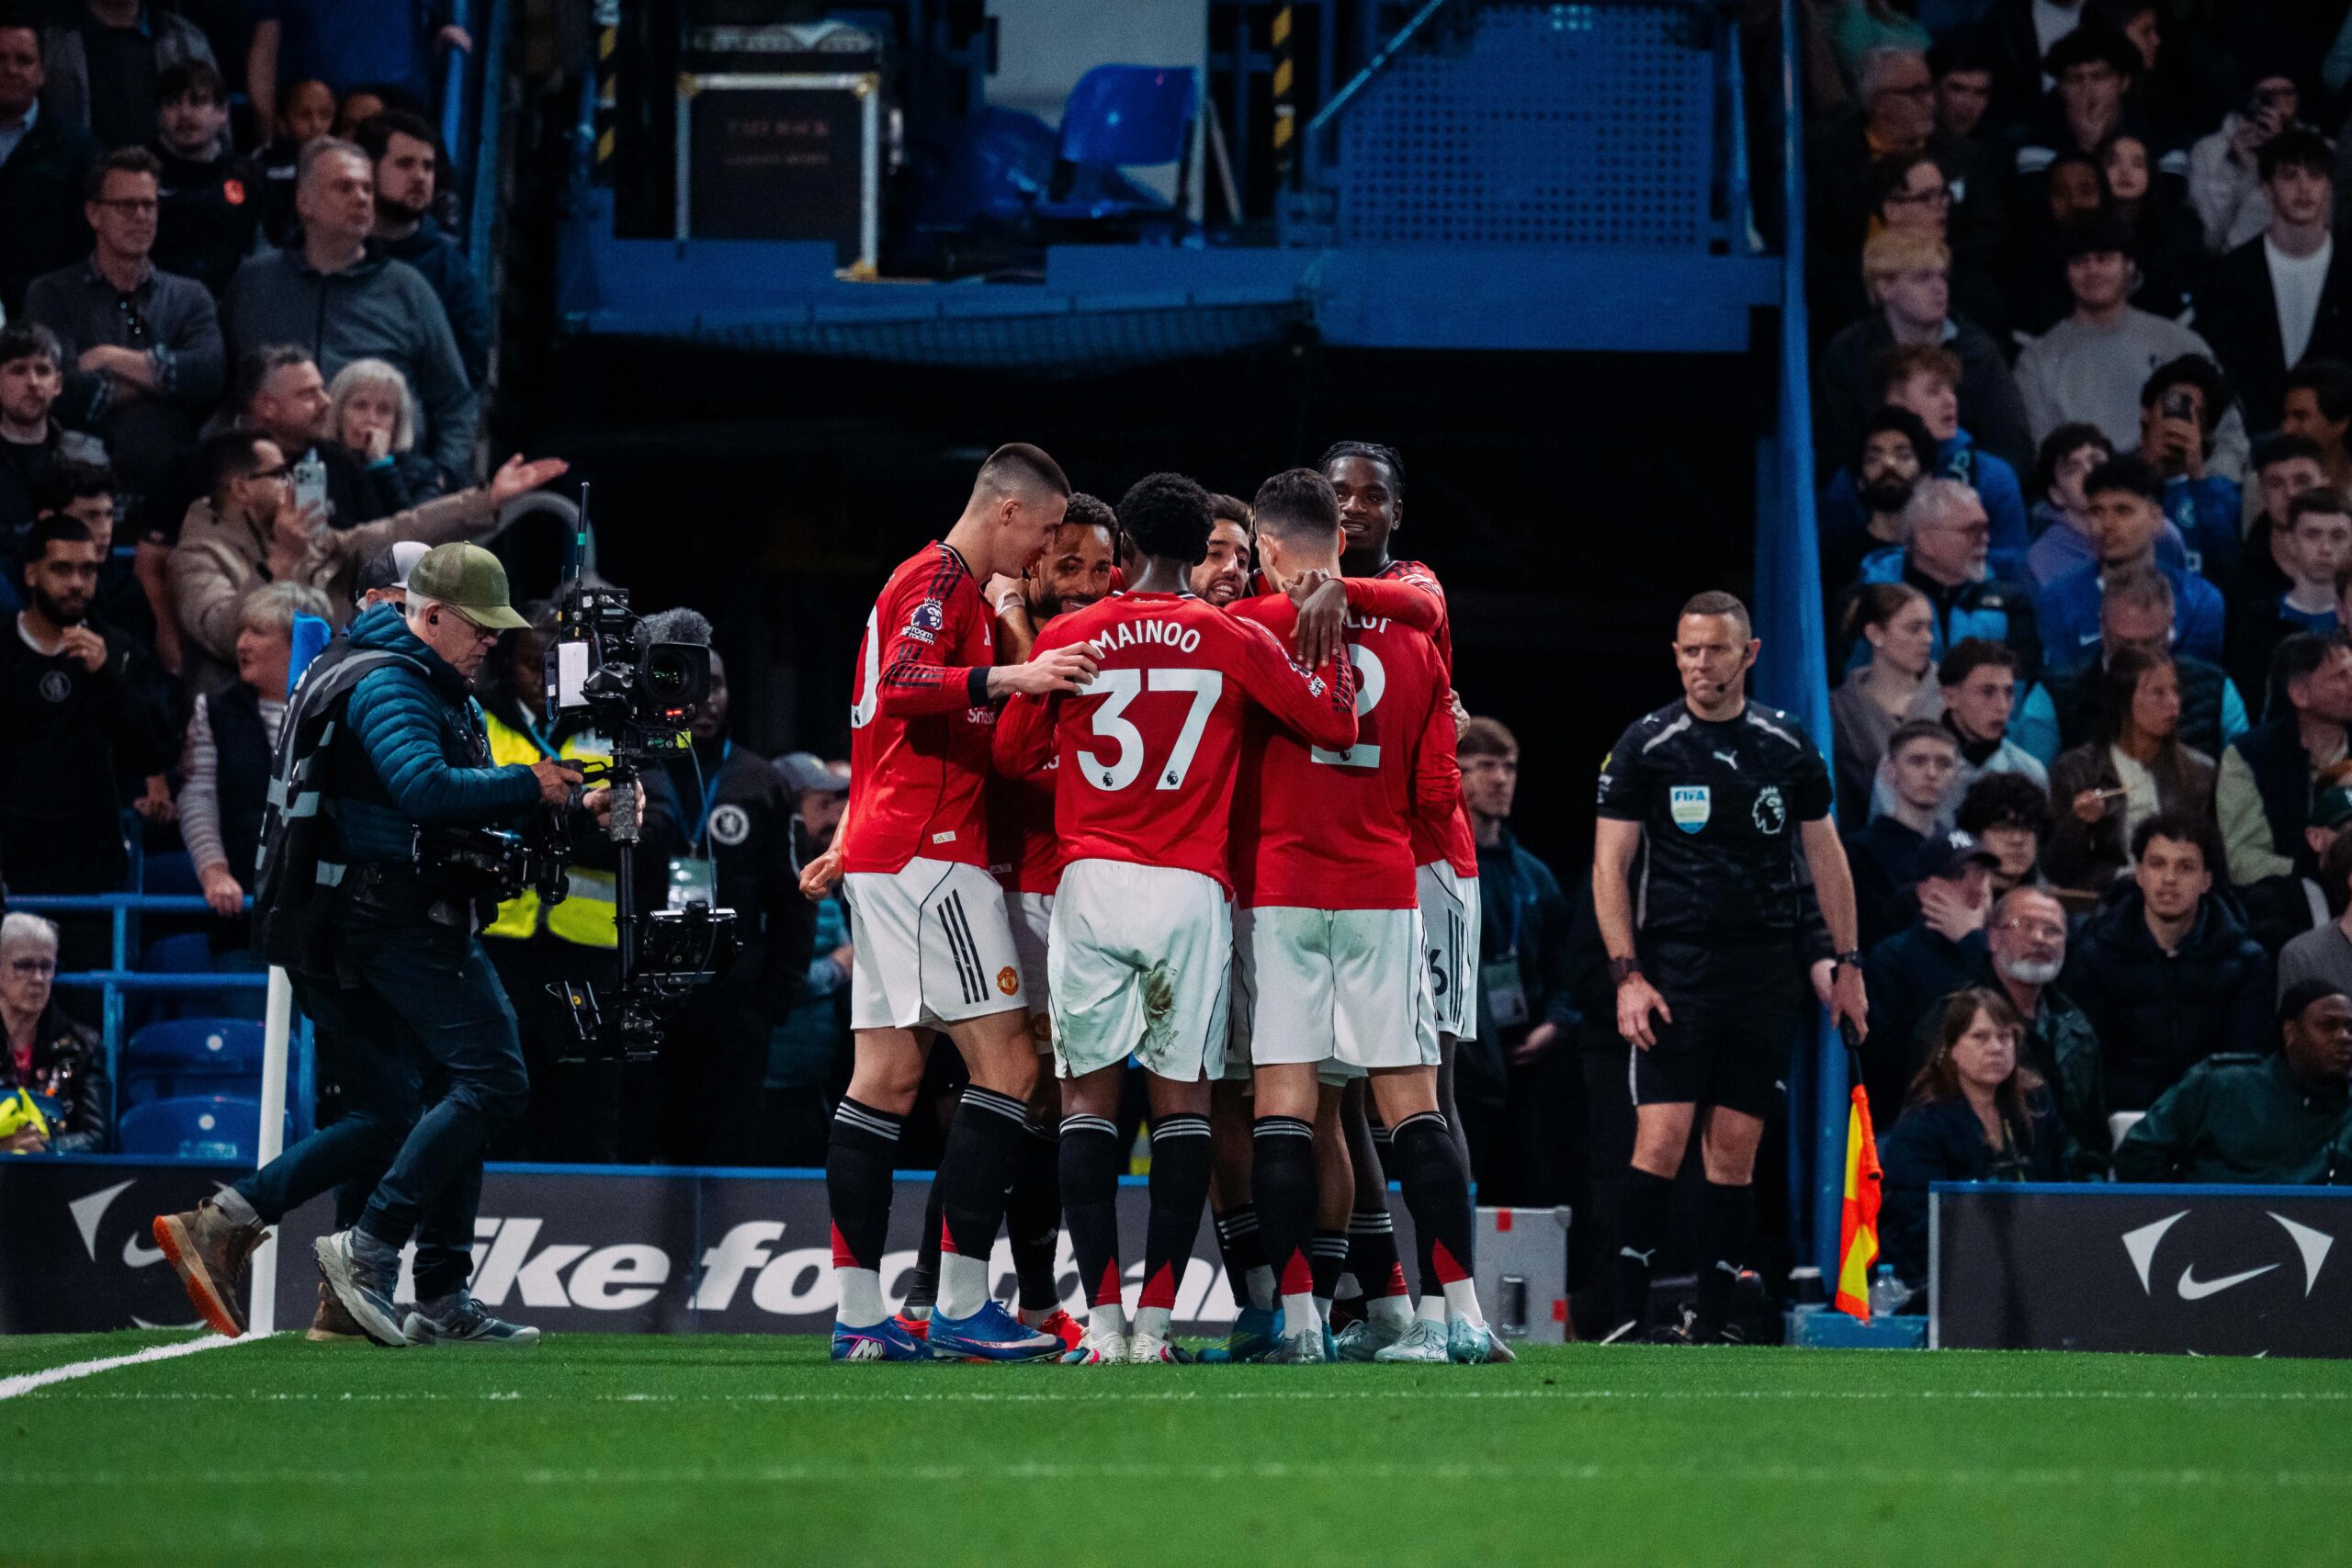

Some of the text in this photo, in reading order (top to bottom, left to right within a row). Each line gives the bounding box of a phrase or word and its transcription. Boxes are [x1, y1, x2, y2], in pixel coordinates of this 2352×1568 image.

[1089, 619, 1201, 659] MAINOO
[1342, 611, 1392, 634] LOT
[1076, 668, 1223, 791] 37
[393, 1218, 671, 1310] ike
